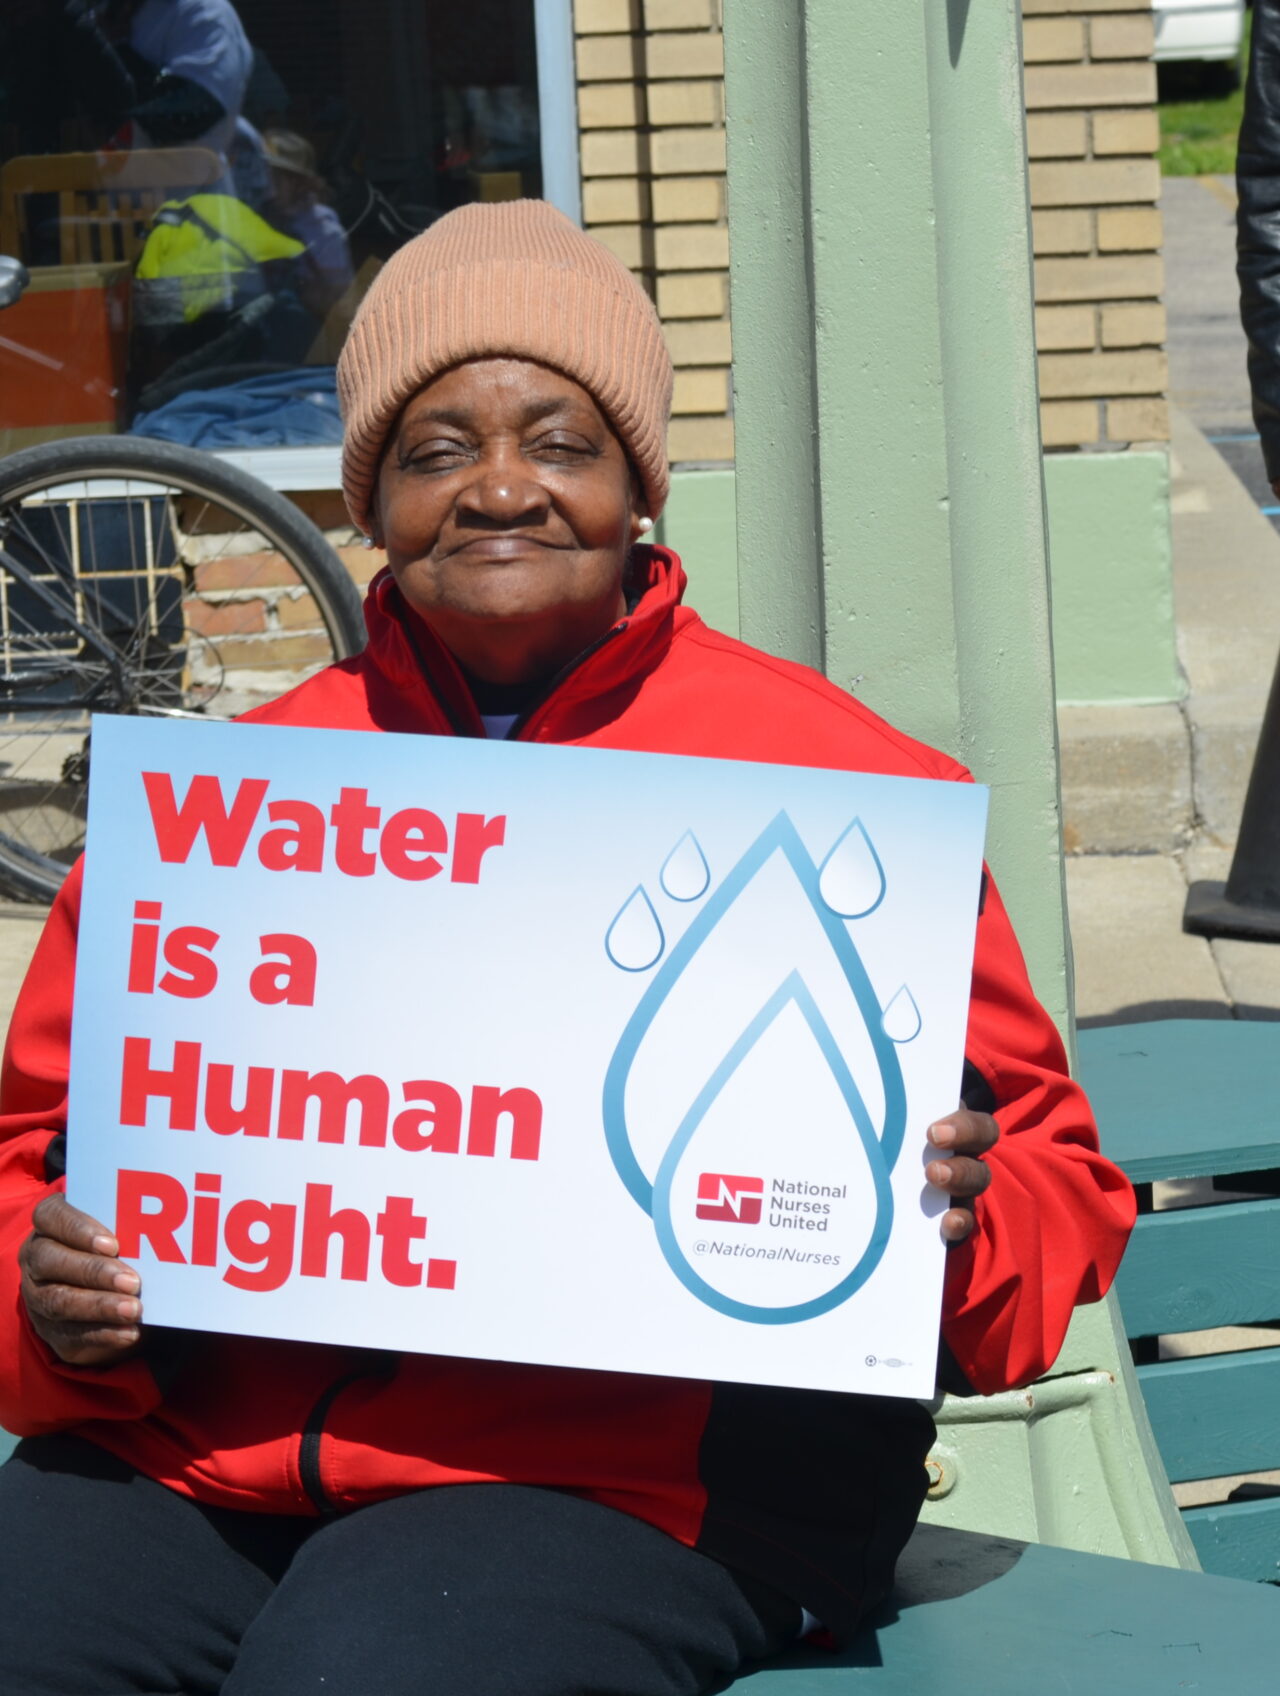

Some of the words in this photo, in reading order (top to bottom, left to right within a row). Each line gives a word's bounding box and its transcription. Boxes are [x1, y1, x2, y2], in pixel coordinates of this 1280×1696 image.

[141, 771, 507, 885] Water
[127, 900, 220, 999] is
[248, 932, 318, 1007] a
[119, 1036, 543, 1161] Human
[769, 1196, 831, 1215] Nurses
[771, 1178, 847, 1199] National
[115, 1168, 458, 1293] Right.
[692, 1239, 842, 1267] @NationalNurses
[768, 1214, 829, 1233] United
